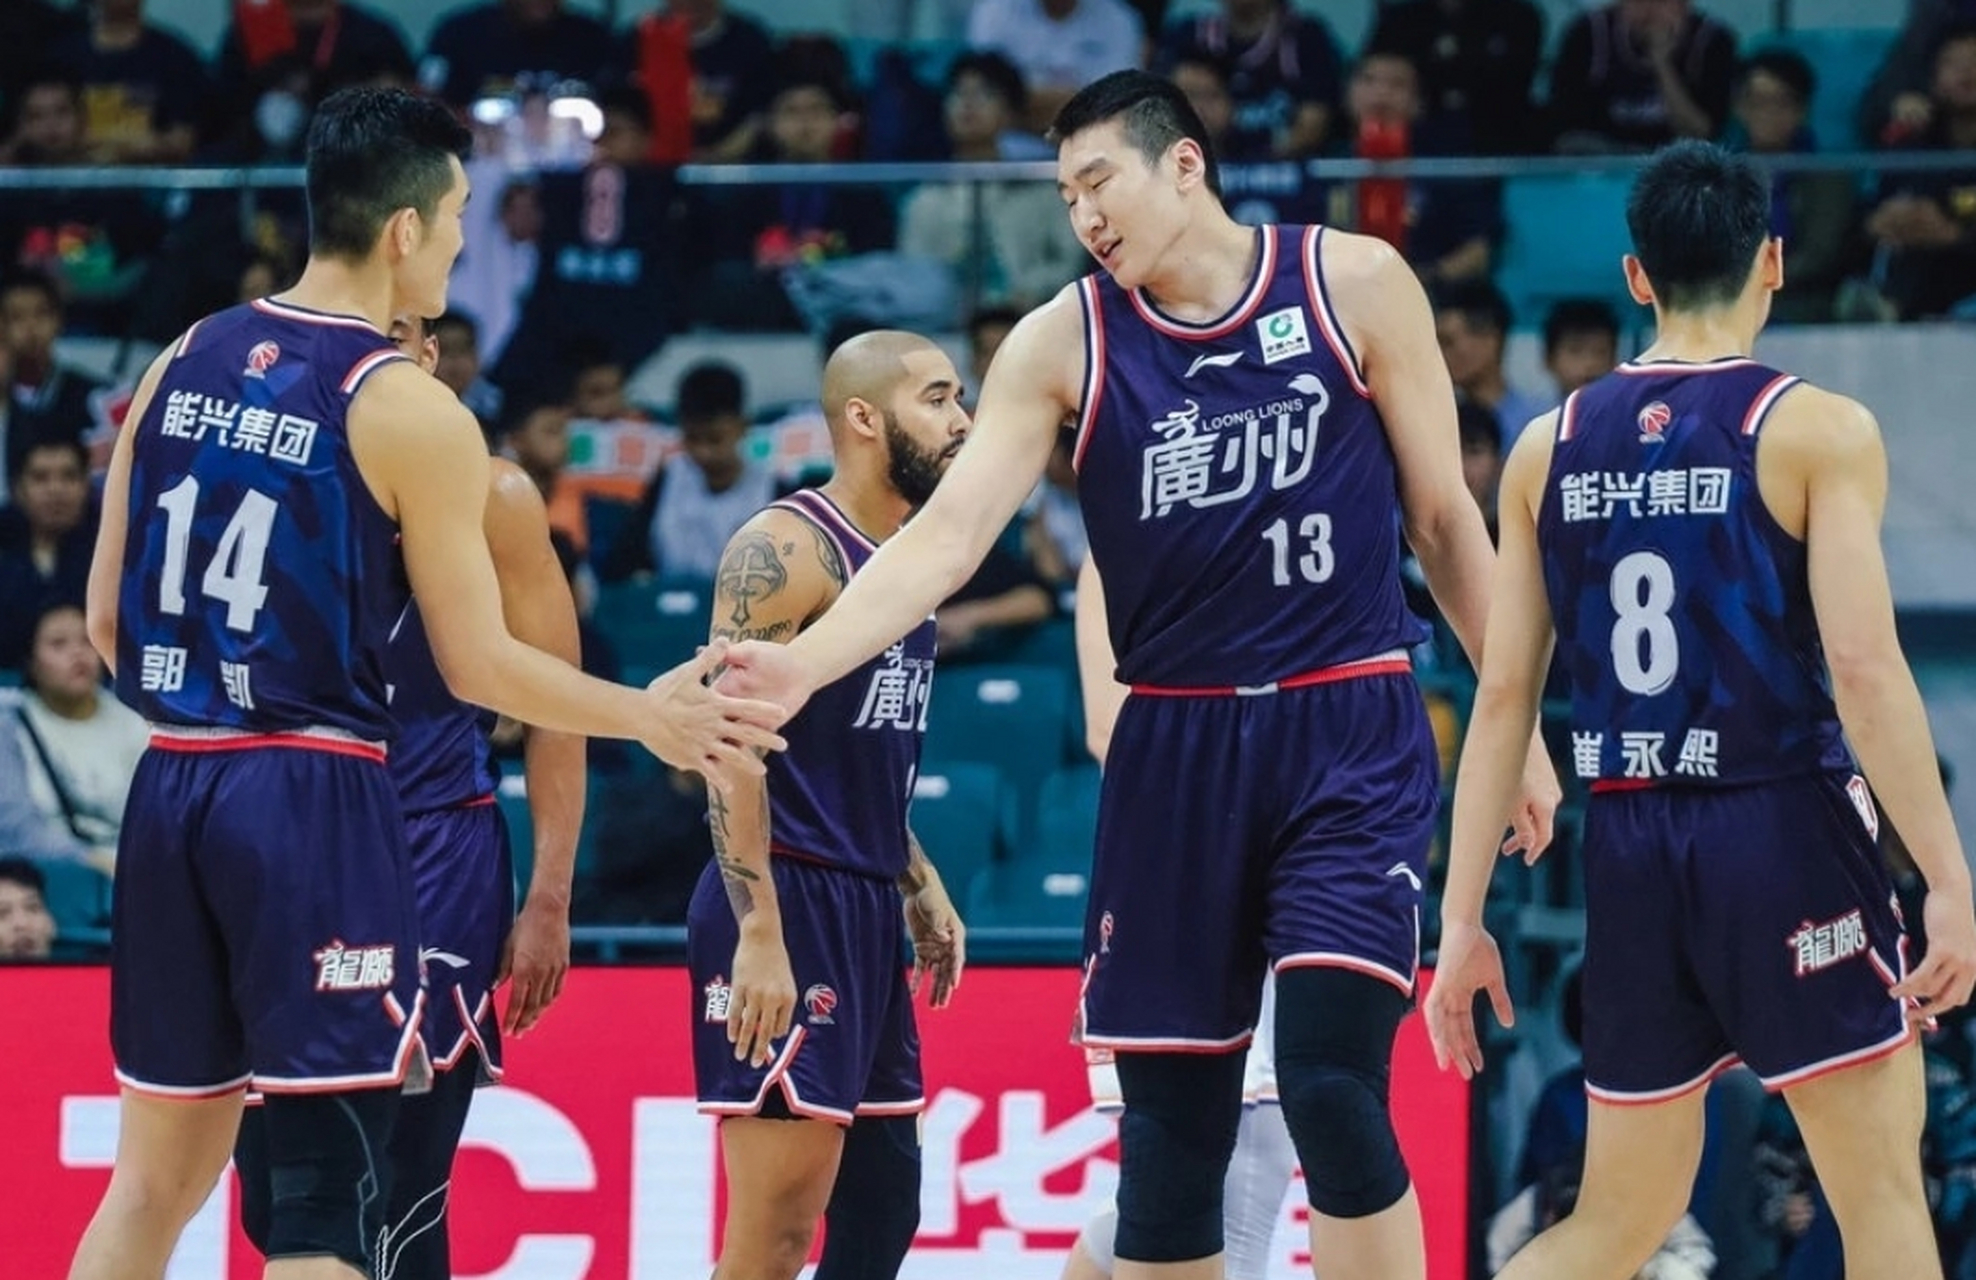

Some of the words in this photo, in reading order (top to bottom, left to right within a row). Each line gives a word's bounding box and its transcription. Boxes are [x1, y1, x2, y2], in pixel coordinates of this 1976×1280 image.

[161, 390, 319, 466] 能兴集团
[1140, 373, 1330, 520] 廣州
[1202, 409, 1255, 432] LOONG
[1258, 398, 1304, 419] LIONS
[1560, 467, 1732, 523] 能兴集团
[157, 474, 279, 632] 14
[1262, 513, 1335, 586] 13
[1610, 551, 1679, 696] 8
